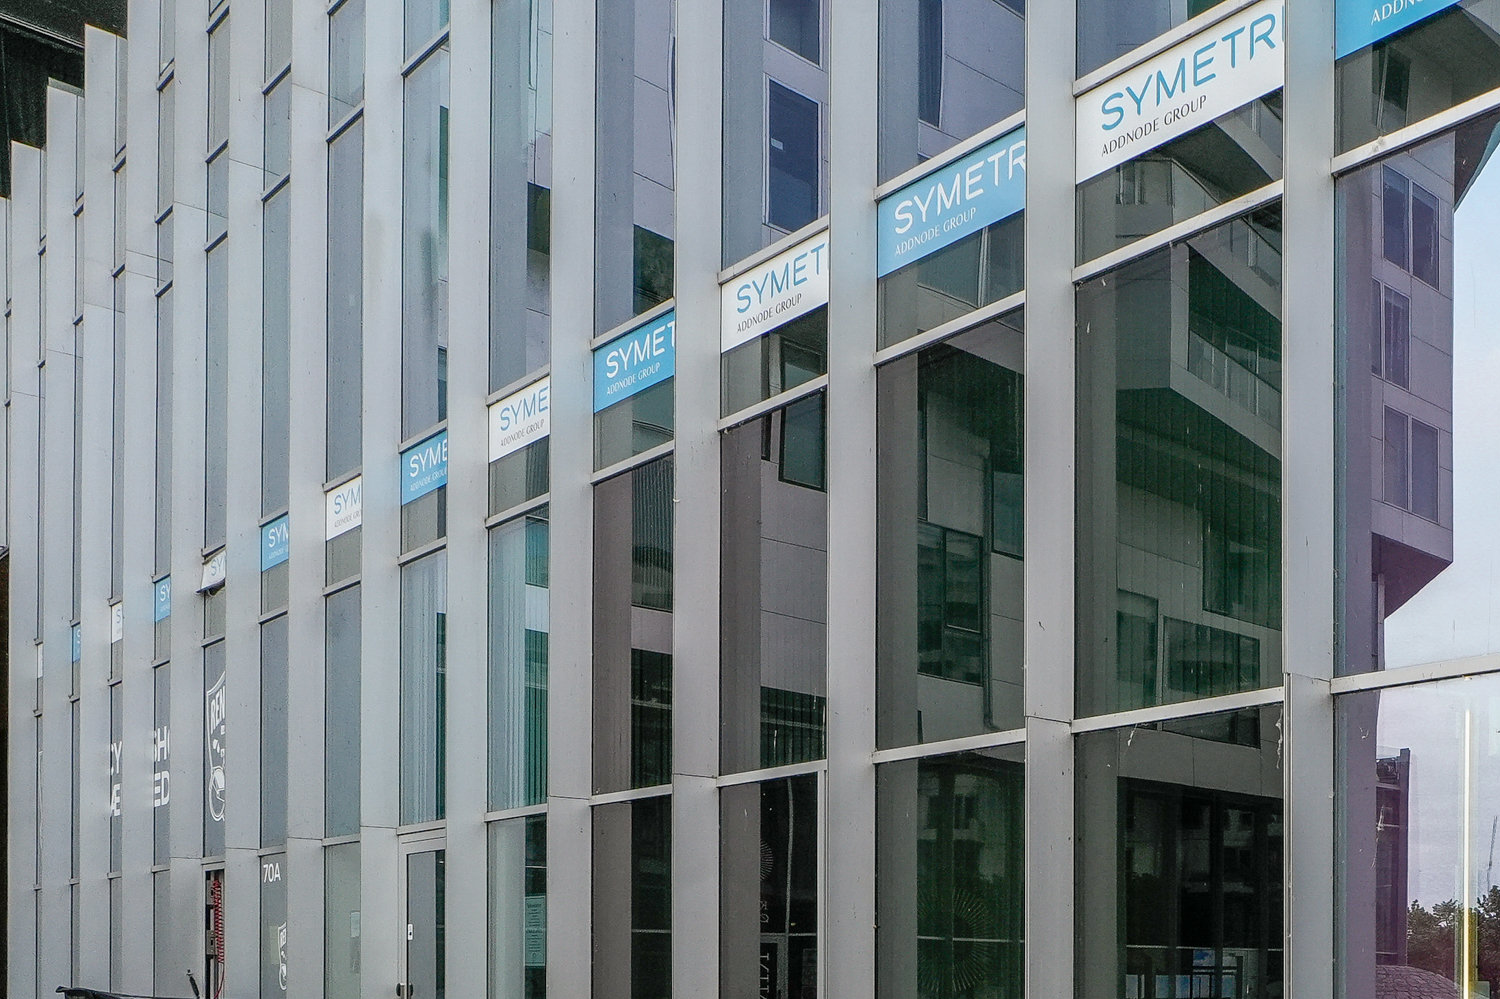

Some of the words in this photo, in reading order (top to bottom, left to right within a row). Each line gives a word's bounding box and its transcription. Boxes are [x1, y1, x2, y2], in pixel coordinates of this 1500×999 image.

[1101, 117, 1160, 158] ADDNODE
[1163, 95, 1208, 127] GROUP
[894, 224, 940, 257] ADDNODE
[943, 207, 977, 233] GROUP
[736, 310, 774, 334] ADDNODE
[775, 293, 803, 316] GROUP
[263, 862, 282, 884] 70A
